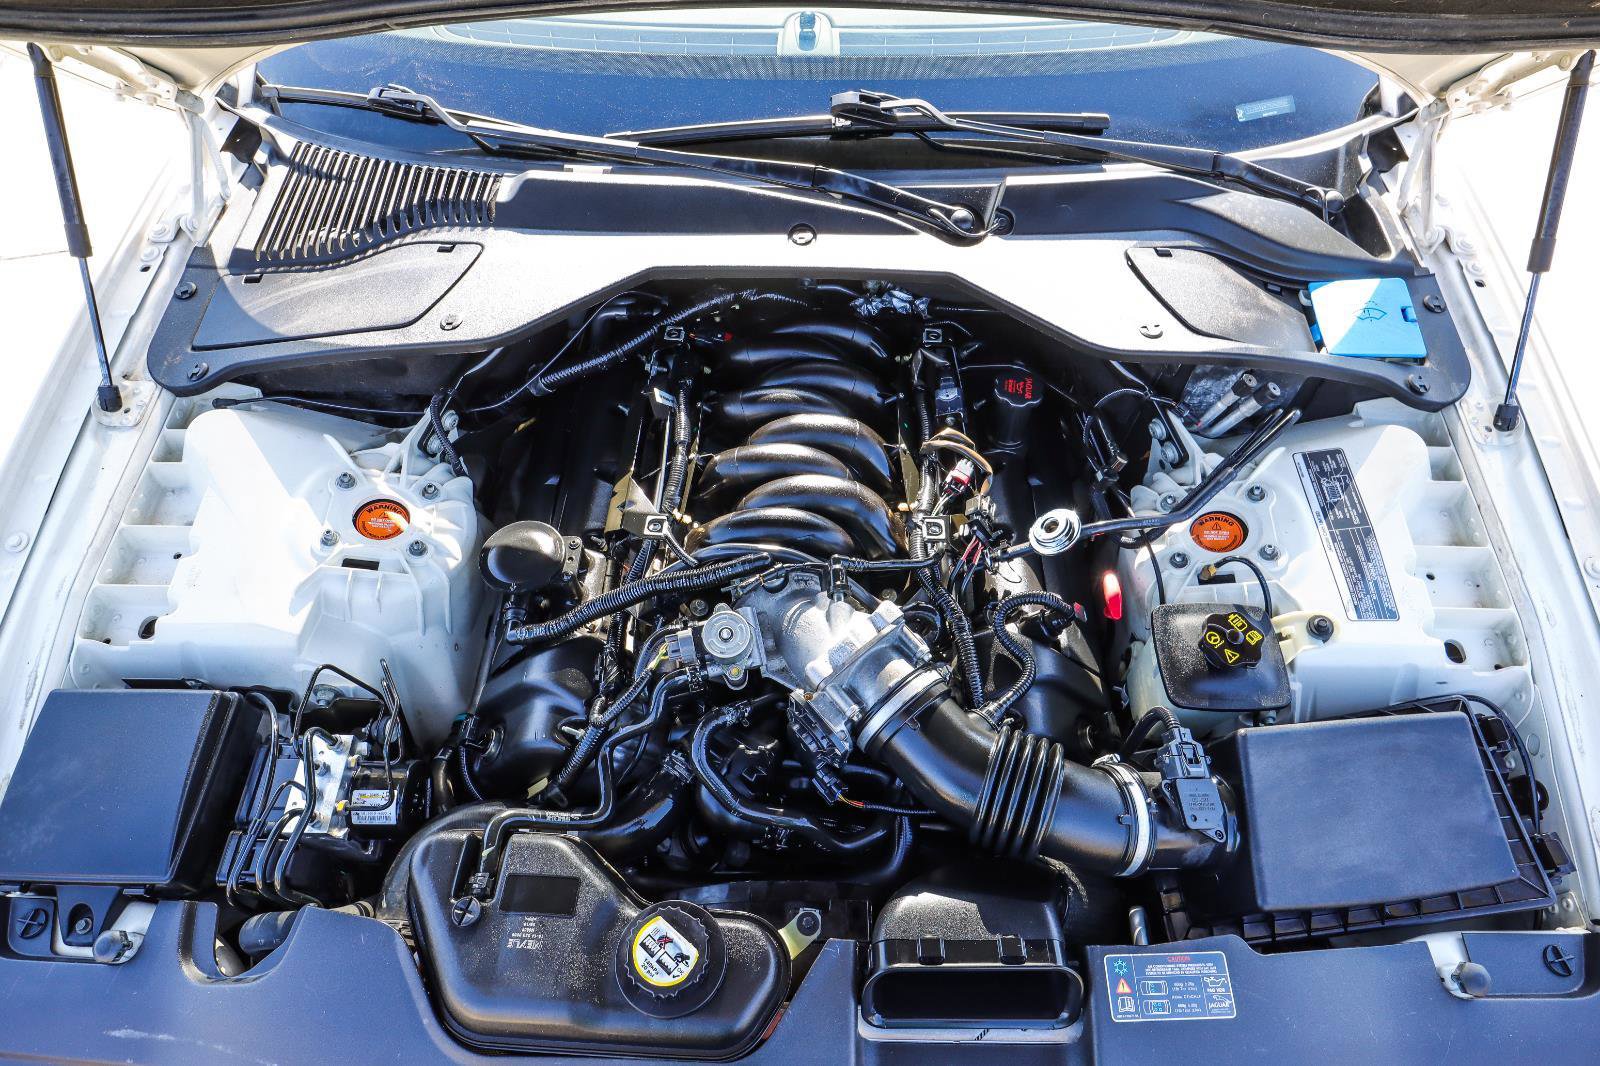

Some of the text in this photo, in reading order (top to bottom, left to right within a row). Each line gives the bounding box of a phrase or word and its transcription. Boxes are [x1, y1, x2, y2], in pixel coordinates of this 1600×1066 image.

[1025, 377, 1033, 400] JAGUAR
[366, 504, 402, 514] WARNING
[1199, 516, 1234, 526] WARNING
[1208, 1001, 1230, 1009] JAGUAR
